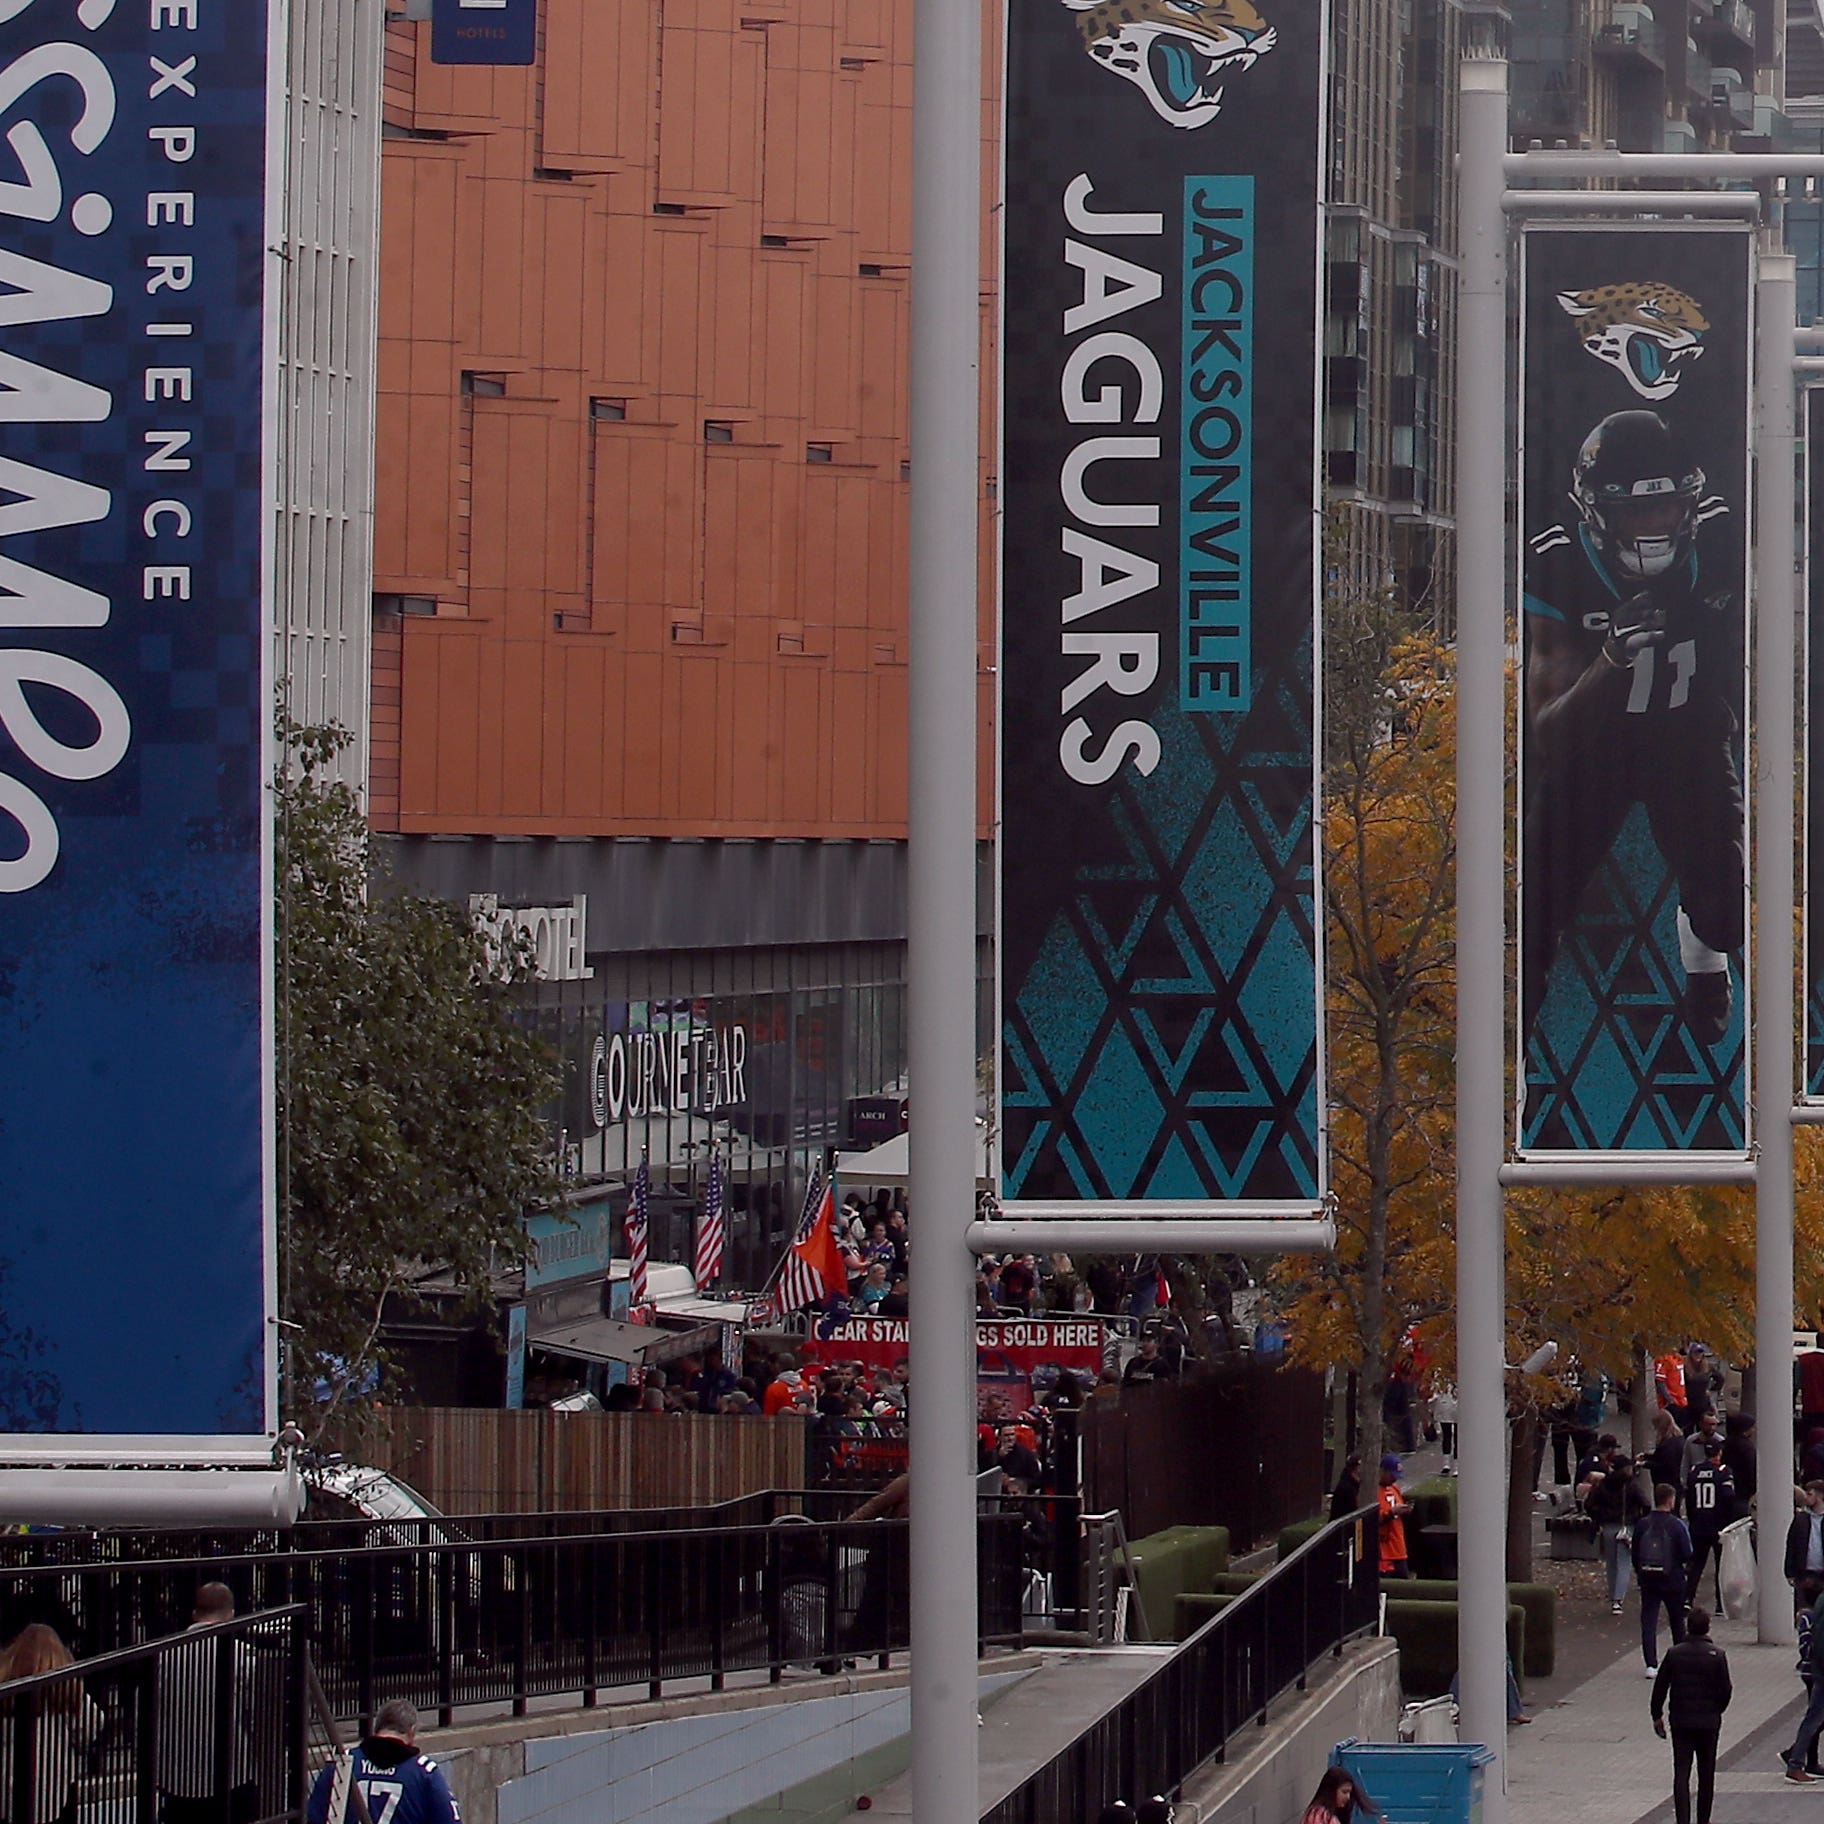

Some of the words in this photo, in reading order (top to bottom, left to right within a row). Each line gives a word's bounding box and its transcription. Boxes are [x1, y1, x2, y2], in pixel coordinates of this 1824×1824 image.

[1059, 173, 1164, 785] JAGUARS
[1189, 187, 1245, 701] JACKSONVILLE
[591, 1029, 704, 1127] GOURMET
[872, 1320, 909, 1342] STA
[1003, 1325, 1048, 1348] SOLD
[1053, 1325, 1099, 1348] HERE
[1694, 1482, 1716, 1509] 10
